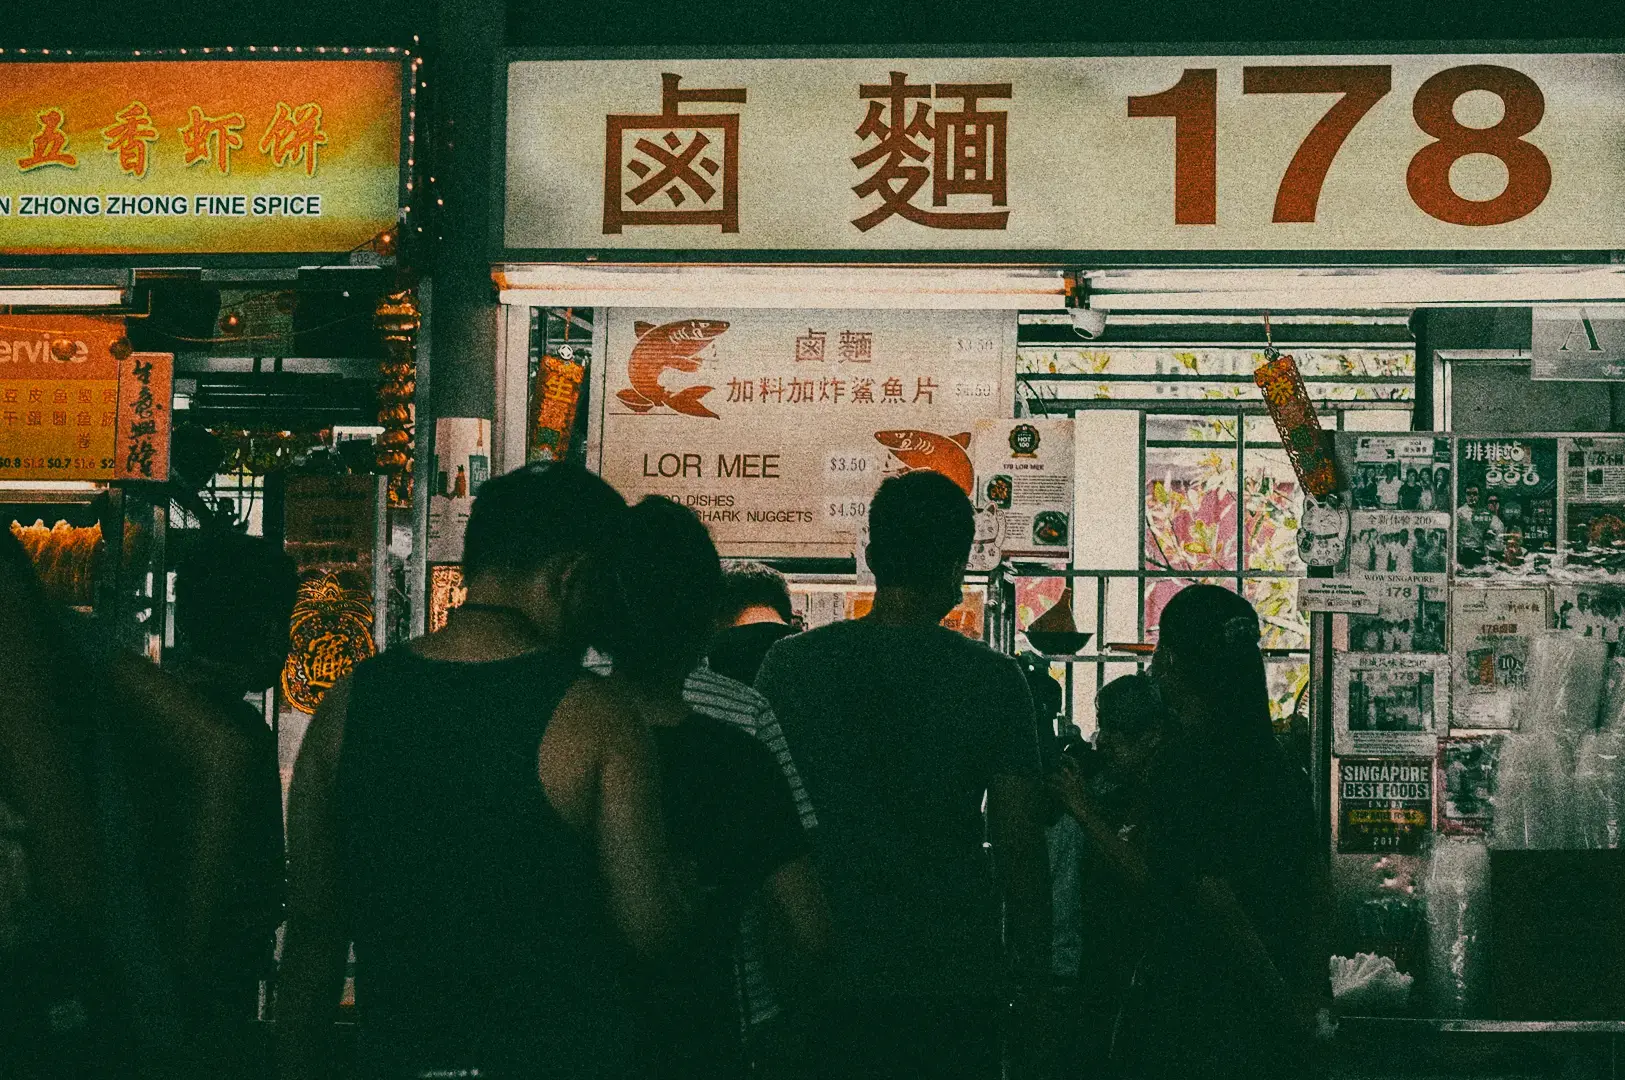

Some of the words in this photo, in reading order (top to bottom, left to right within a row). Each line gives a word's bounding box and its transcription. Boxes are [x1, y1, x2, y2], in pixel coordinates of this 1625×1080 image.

[1127, 66, 1551, 226] 178
[19, 197, 101, 215] ZHONG
[106, 197, 188, 215] ZHONG
[195, 197, 245, 214] FINE
[253, 197, 321, 215] SPICE
[1558, 307, 1604, 351] A
[48, 457, 71, 469] $0.7
[74, 457, 95, 469] $1.6
[643, 454, 702, 478] LOR
[717, 454, 781, 478] MEE
[829, 457, 866, 472] $3.50
[686, 495, 735, 507] DISHES
[746, 511, 813, 523] NUGGETS
[829, 502, 866, 517] $4.50
[1364, 574, 1386, 582] WOW
[1388, 574, 1434, 583] SINGAPORE
[1386, 587, 1411, 598] 178
[1344, 765, 1429, 782] SINGAPORE
[1346, 783, 1379, 798] BEST
[1382, 783, 1426, 798] FOODS
